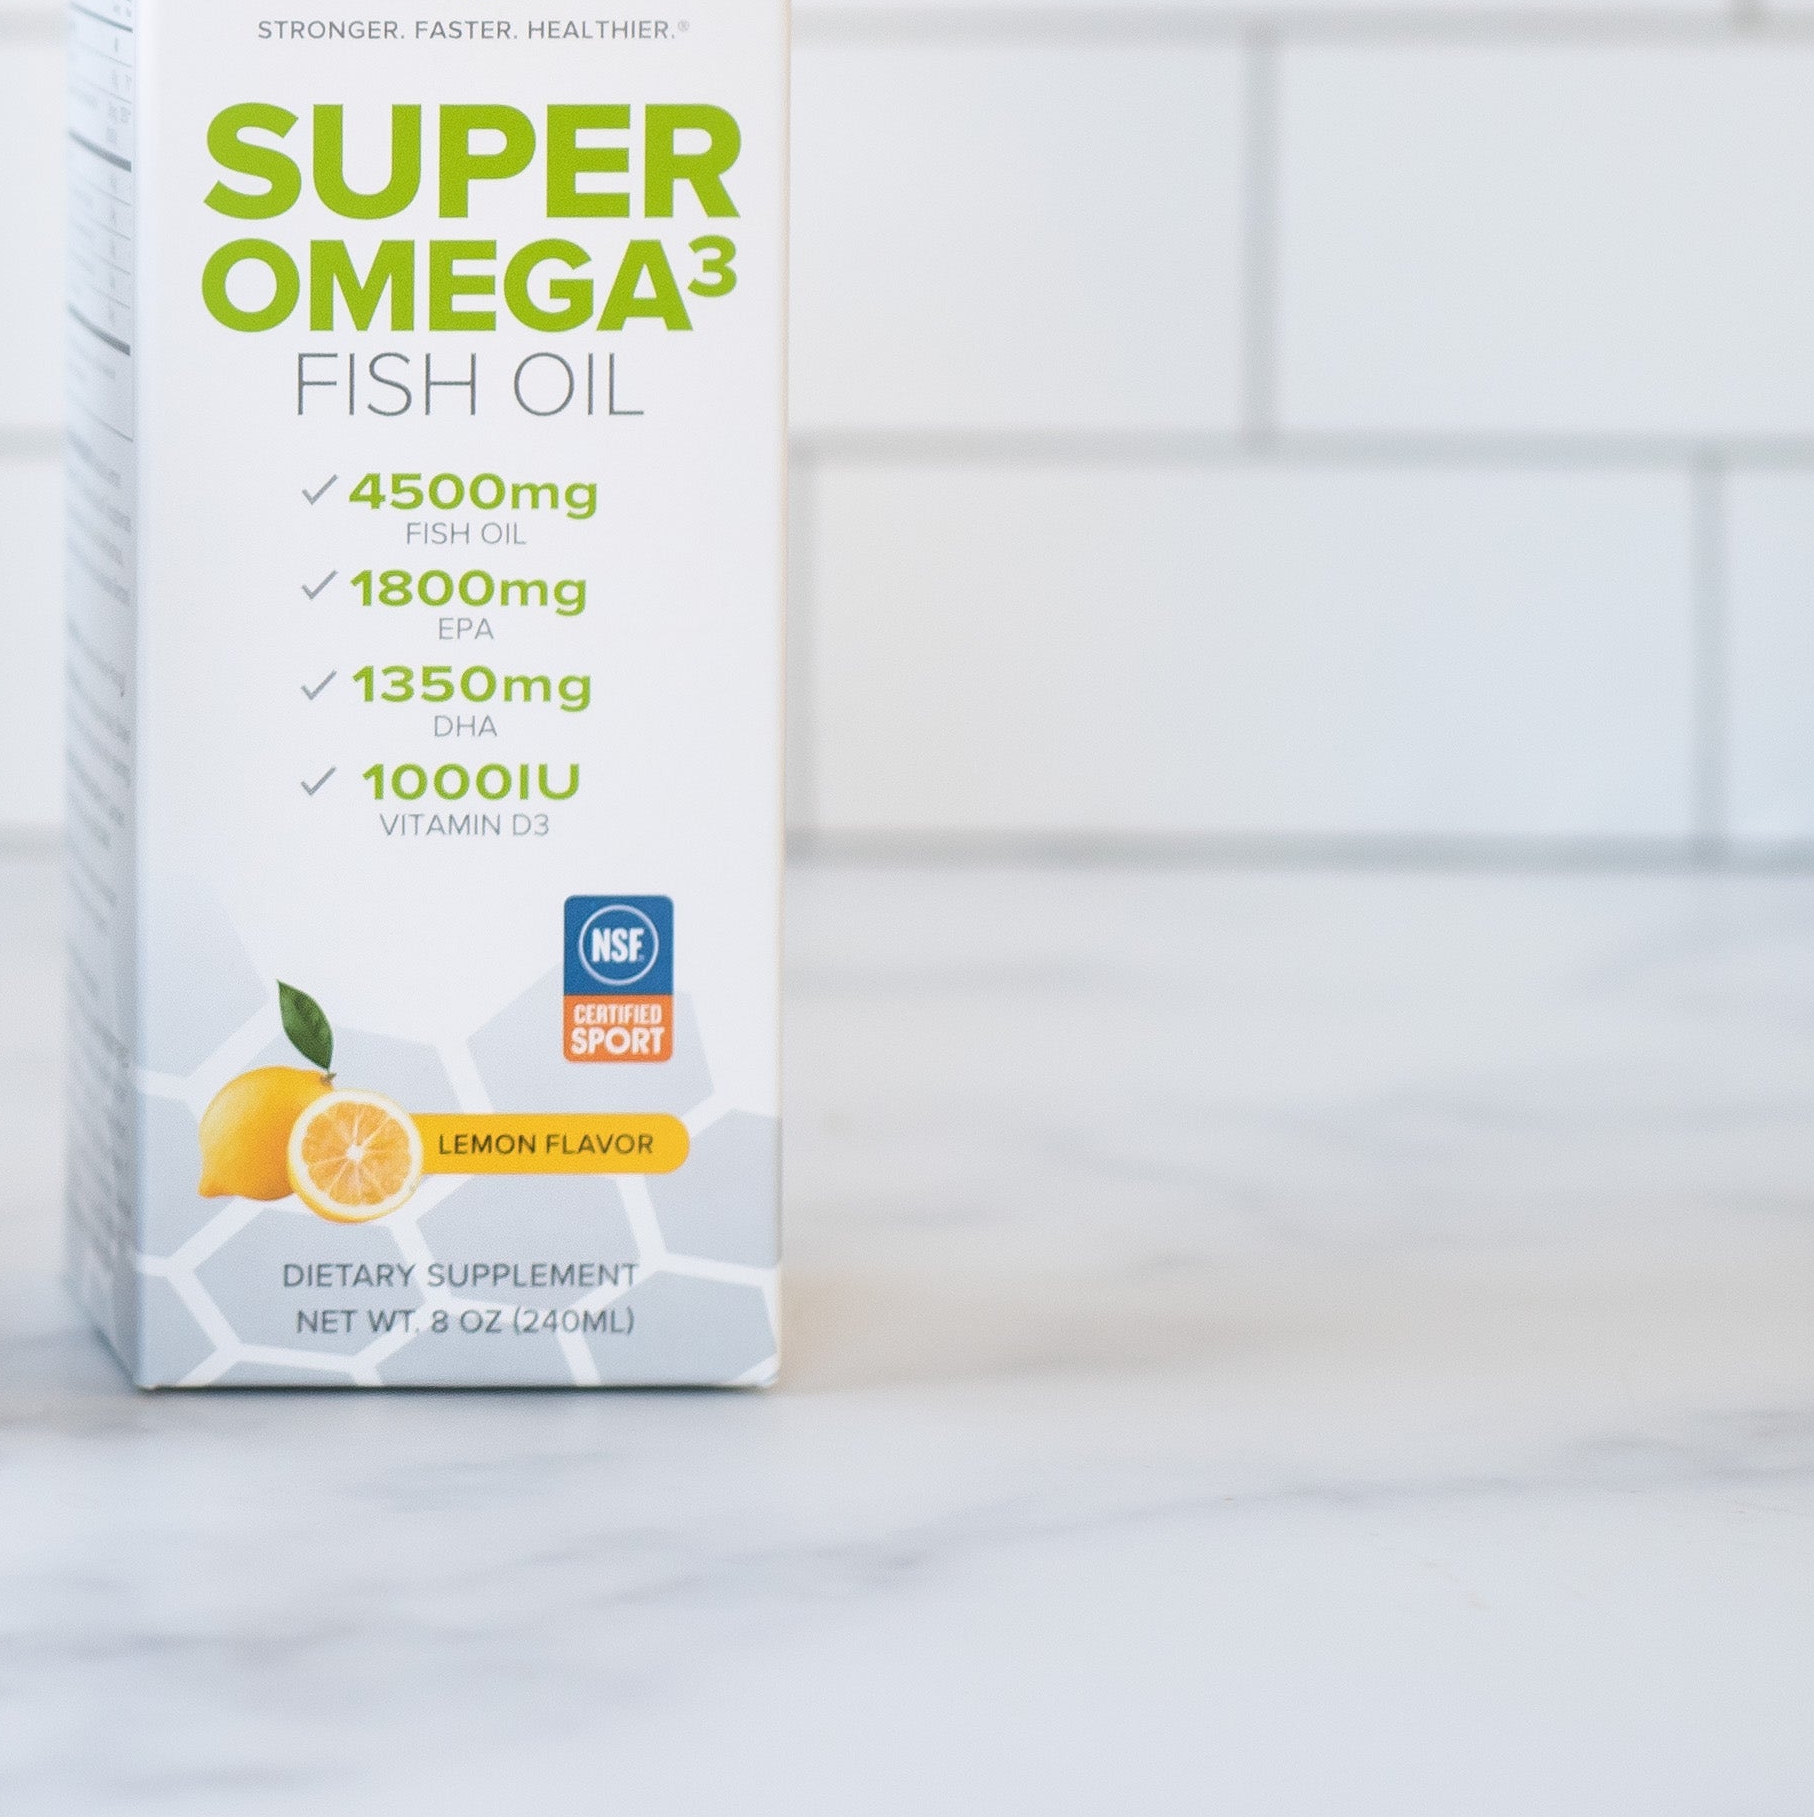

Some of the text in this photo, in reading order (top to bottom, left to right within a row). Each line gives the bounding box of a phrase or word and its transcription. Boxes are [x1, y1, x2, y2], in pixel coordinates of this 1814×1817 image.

[258, 20, 405, 40] STRONGER.
[415, 20, 519, 40] FASTER.
[203, 102, 741, 220] SUPER
[297, 352, 645, 417] FISH OIL
[348, 472, 598, 520] 4500mg
[406, 522, 527, 545] FISH OIL
[349, 569, 587, 617] 1800mg
[438, 617, 494, 640] EPA
[351, 665, 591, 713] 1350mg
[433, 714, 498, 738] DHA
[362, 762, 580, 801] 1000IU
[379, 813, 549, 836] VITAMIN D3
[591, 928, 644, 963] NSF
[573, 1004, 663, 1025] CERTIFIED
[571, 1027, 665, 1055] SPORT
[438, 1133, 655, 1156] LEMON FLAVOR
[283, 1263, 640, 1288] DIETARY SUPPLEMENT
[296, 1309, 635, 1338] NET WT. 8 OZ (240ML)
